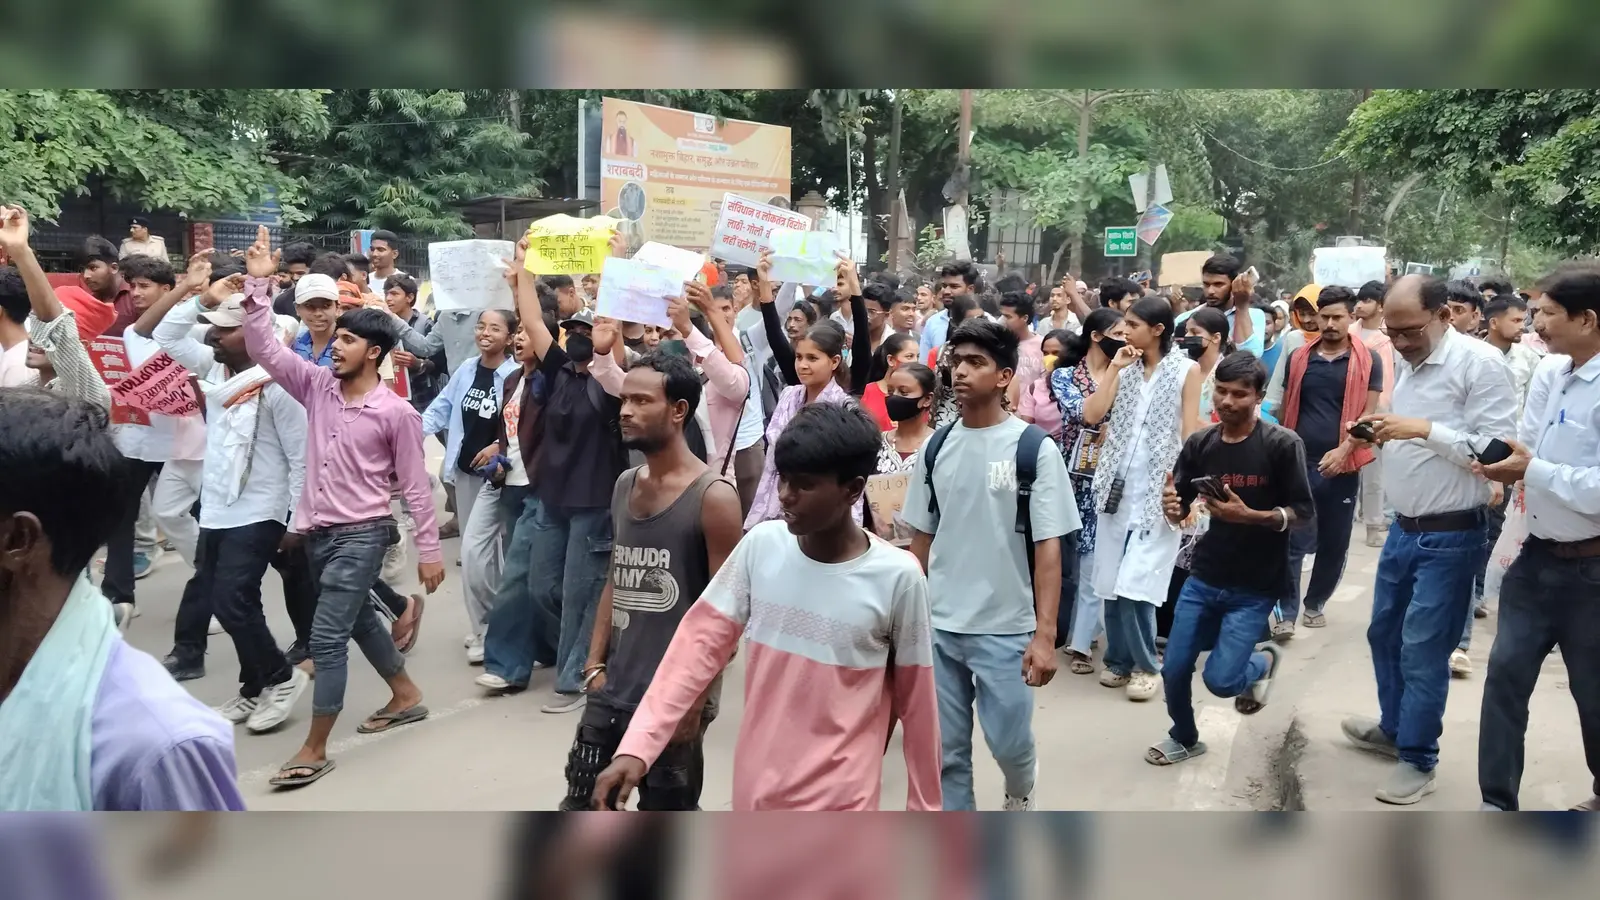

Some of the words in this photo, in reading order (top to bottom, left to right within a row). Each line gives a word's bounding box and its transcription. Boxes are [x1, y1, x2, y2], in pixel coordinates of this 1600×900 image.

[607, 162, 644, 178] शराबबंदी
[727, 201, 755, 218] संविधान
[755, 209, 761, 219] व
[761, 209, 787, 227] लोकतंत्र
[746, 223, 764, 237] गोली
[722, 234, 738, 246] नहीं
[578, 245, 594, 256] का
[621, 567, 647, 588] MY
